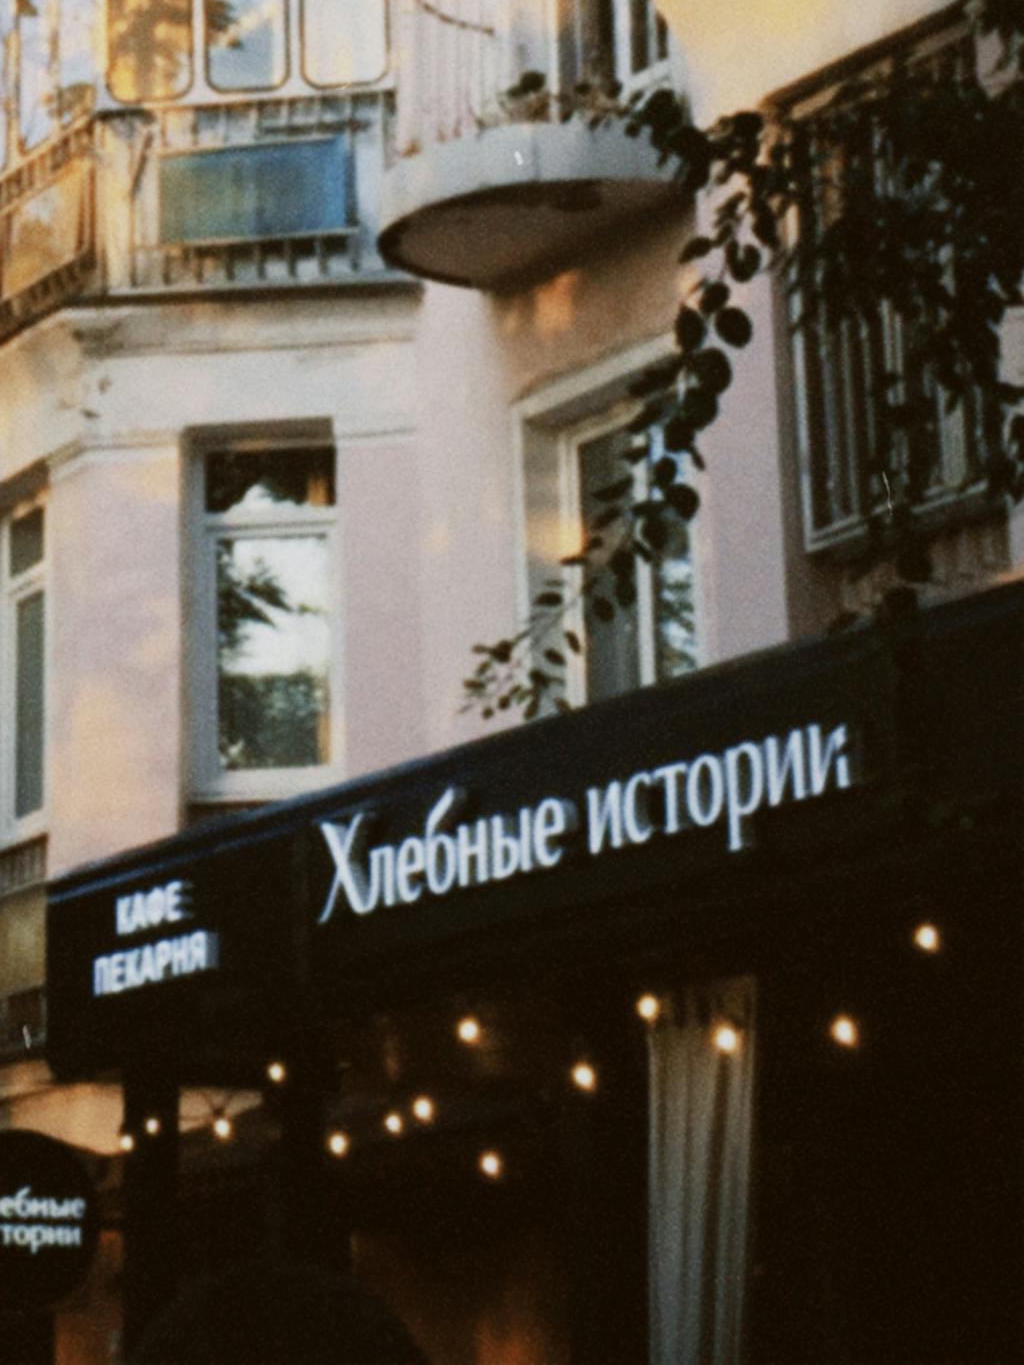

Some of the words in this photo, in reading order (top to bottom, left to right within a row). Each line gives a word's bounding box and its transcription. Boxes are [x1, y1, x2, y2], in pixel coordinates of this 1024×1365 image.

[318, 786, 566, 925] Хлебные
[586, 722, 851, 853] истории
[115, 879, 186, 935] КАФЕ
[92, 928, 210, 997] ПЕКАРНЯ
